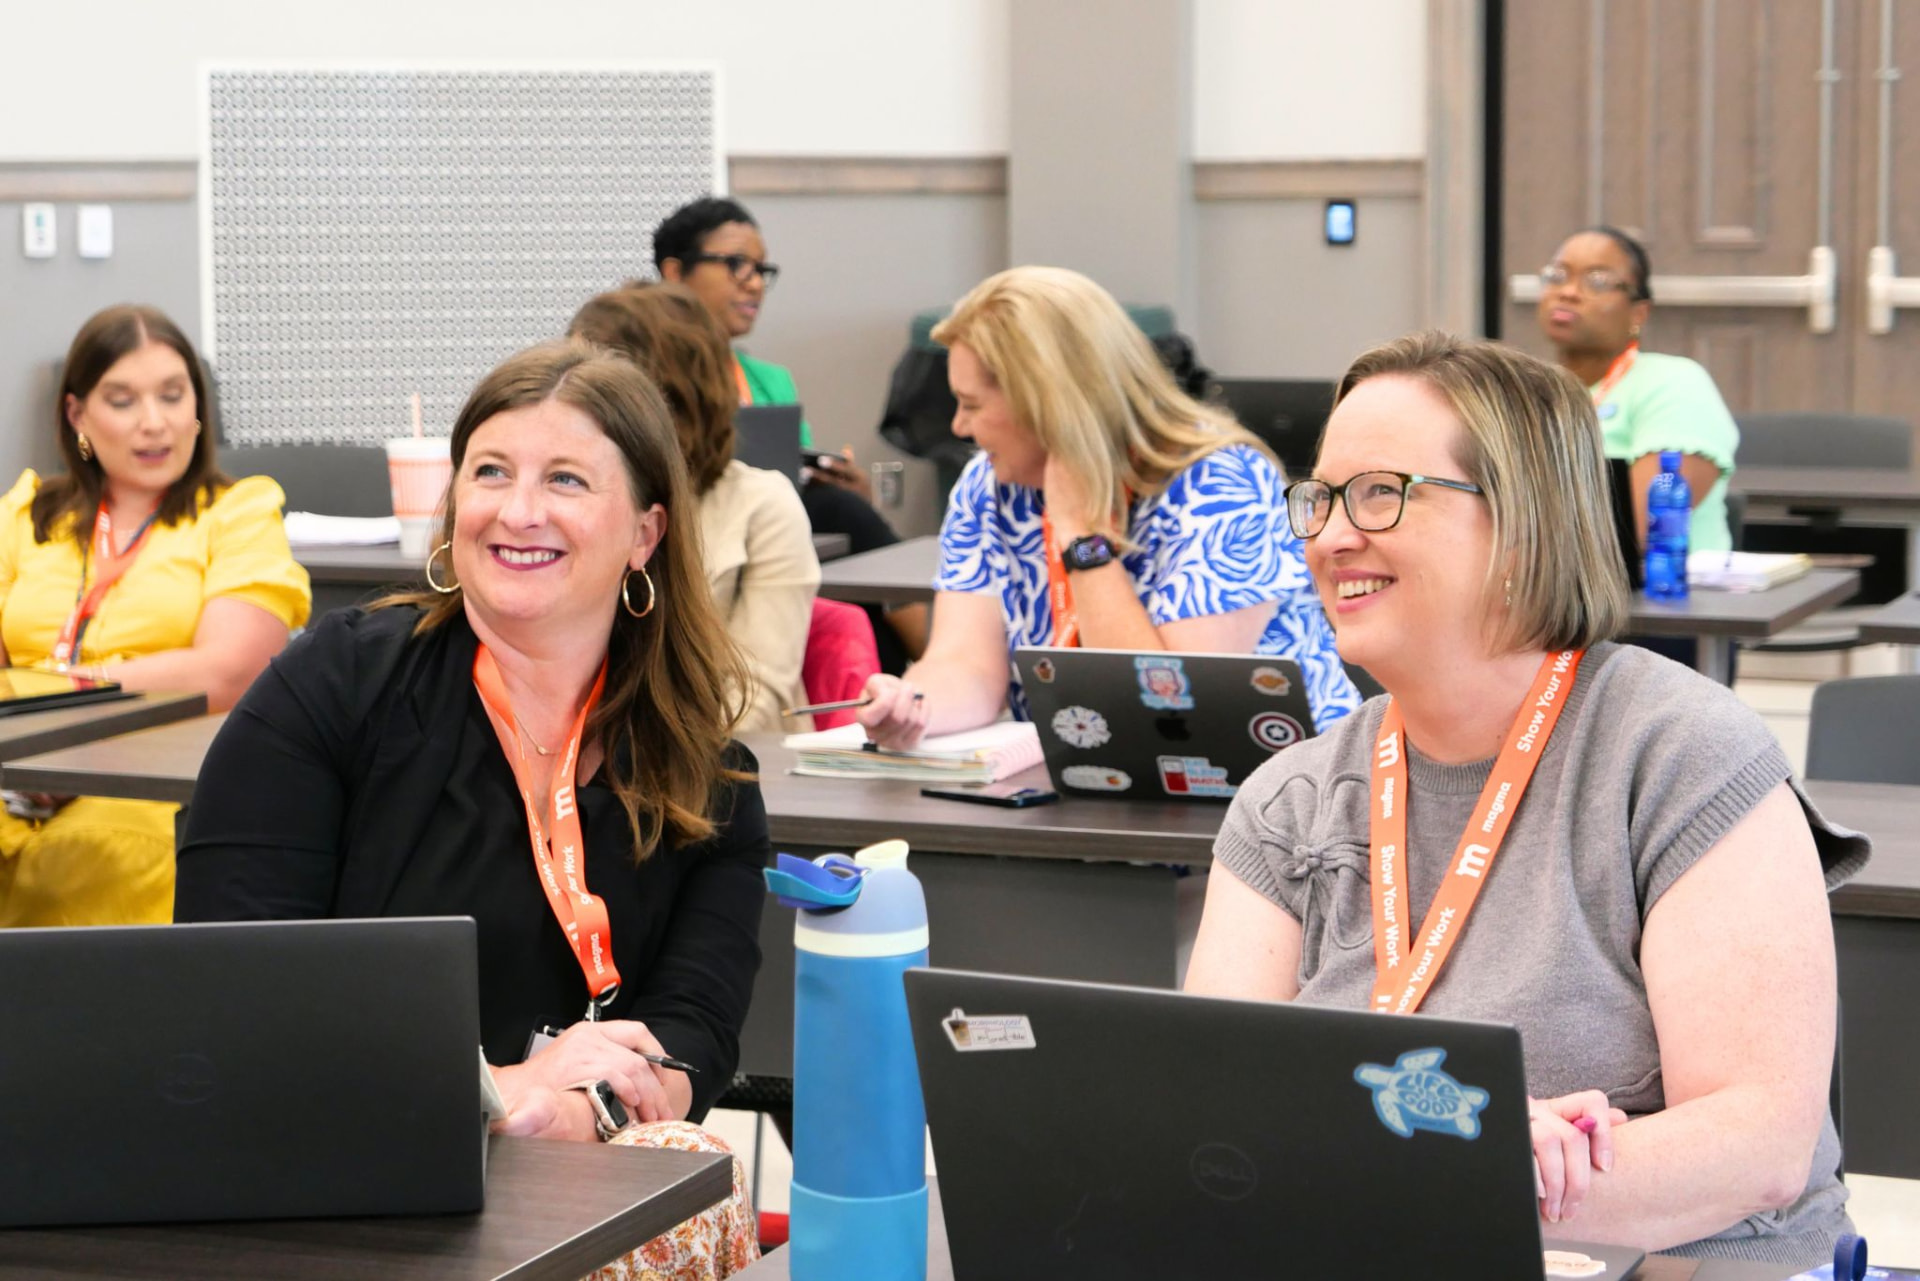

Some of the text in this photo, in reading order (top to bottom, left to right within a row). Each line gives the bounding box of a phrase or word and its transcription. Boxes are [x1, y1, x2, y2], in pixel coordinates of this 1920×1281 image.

[1517, 650, 1574, 753] Show Your Wo
[1381, 777, 1394, 819] magma
[1482, 782, 1512, 833] magma
[542, 863, 562, 896] Work
[563, 845, 576, 875] Work
[1381, 844, 1400, 969] Show Your Work
[590, 932, 605, 975] magma
[1409, 950, 1434, 985] Your
[1425, 907, 1456, 948] Work
[1397, 1090, 1460, 1117] GOOD
